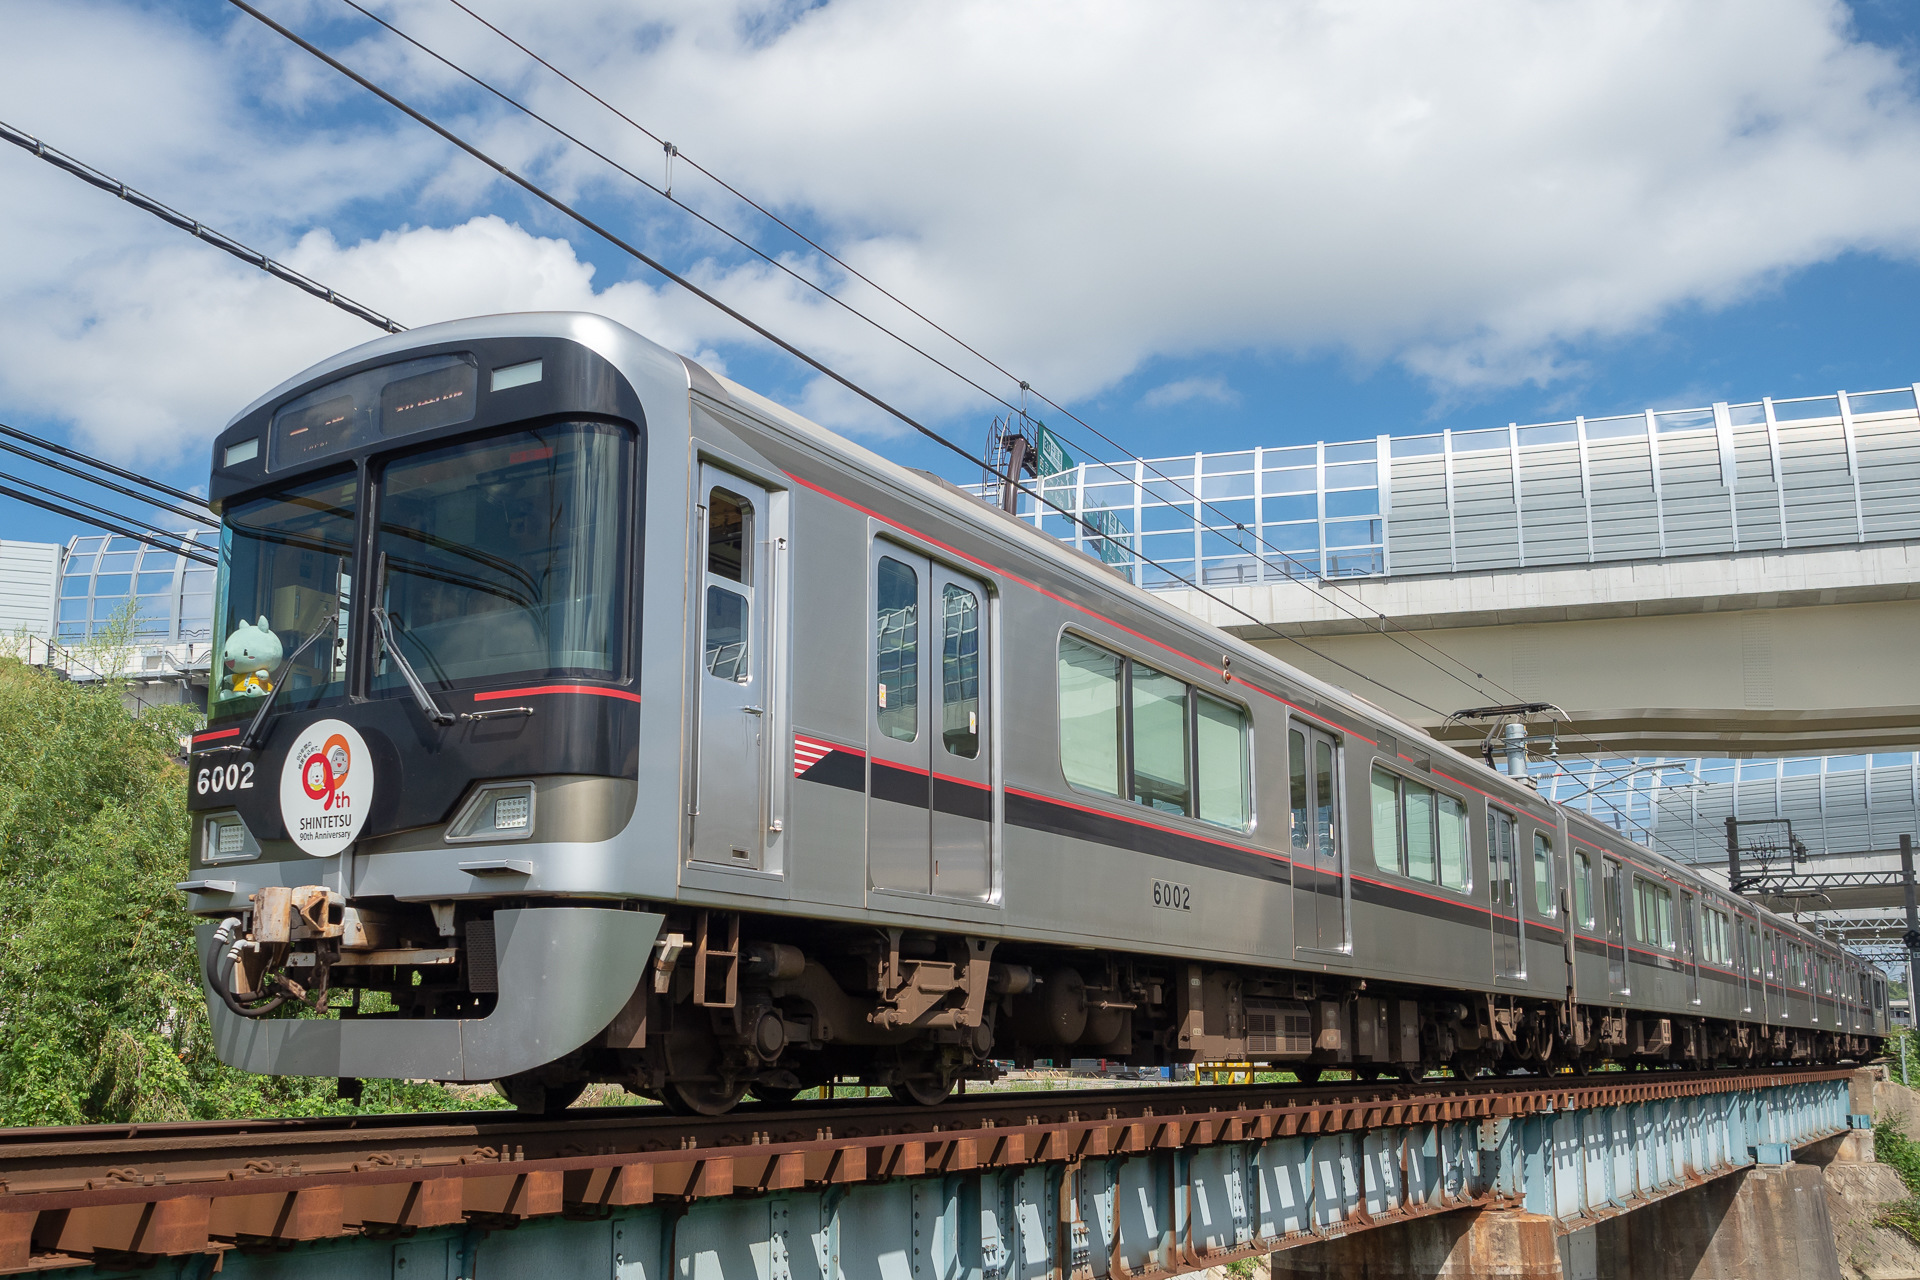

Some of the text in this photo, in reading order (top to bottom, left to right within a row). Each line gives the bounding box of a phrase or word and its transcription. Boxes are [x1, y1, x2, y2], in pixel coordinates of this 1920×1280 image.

[197, 761, 255, 795] 6002
[300, 814, 352, 831] SHINTETSU
[300, 831, 351, 841] 90th Anniversary
[1153, 881, 1190, 910] 6002
